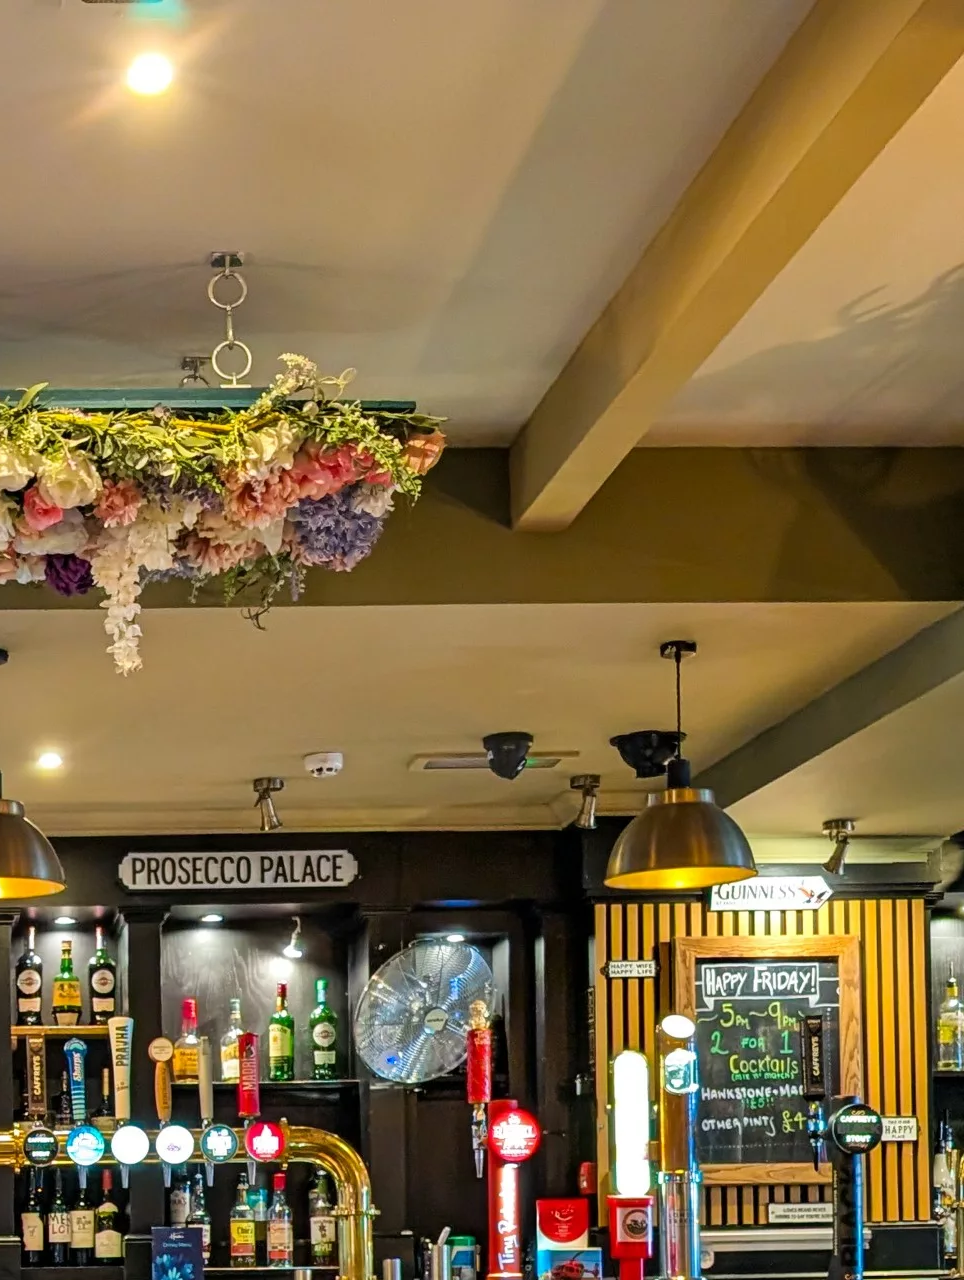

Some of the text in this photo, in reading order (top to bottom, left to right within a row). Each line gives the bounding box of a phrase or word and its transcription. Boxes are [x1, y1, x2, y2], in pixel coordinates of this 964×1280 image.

[131, 854, 344, 885] PROSECCO PALACE
[717, 883, 796, 900] GUINNESS
[752, 966, 816, 997] FRIDAY!
[115, 1024, 129, 1067] PRAVHA
[710, 1029, 794, 1054] 2 FOR 1
[884, 1125, 914, 1134] HAPPY
[497, 1234, 520, 1271] Tiny
